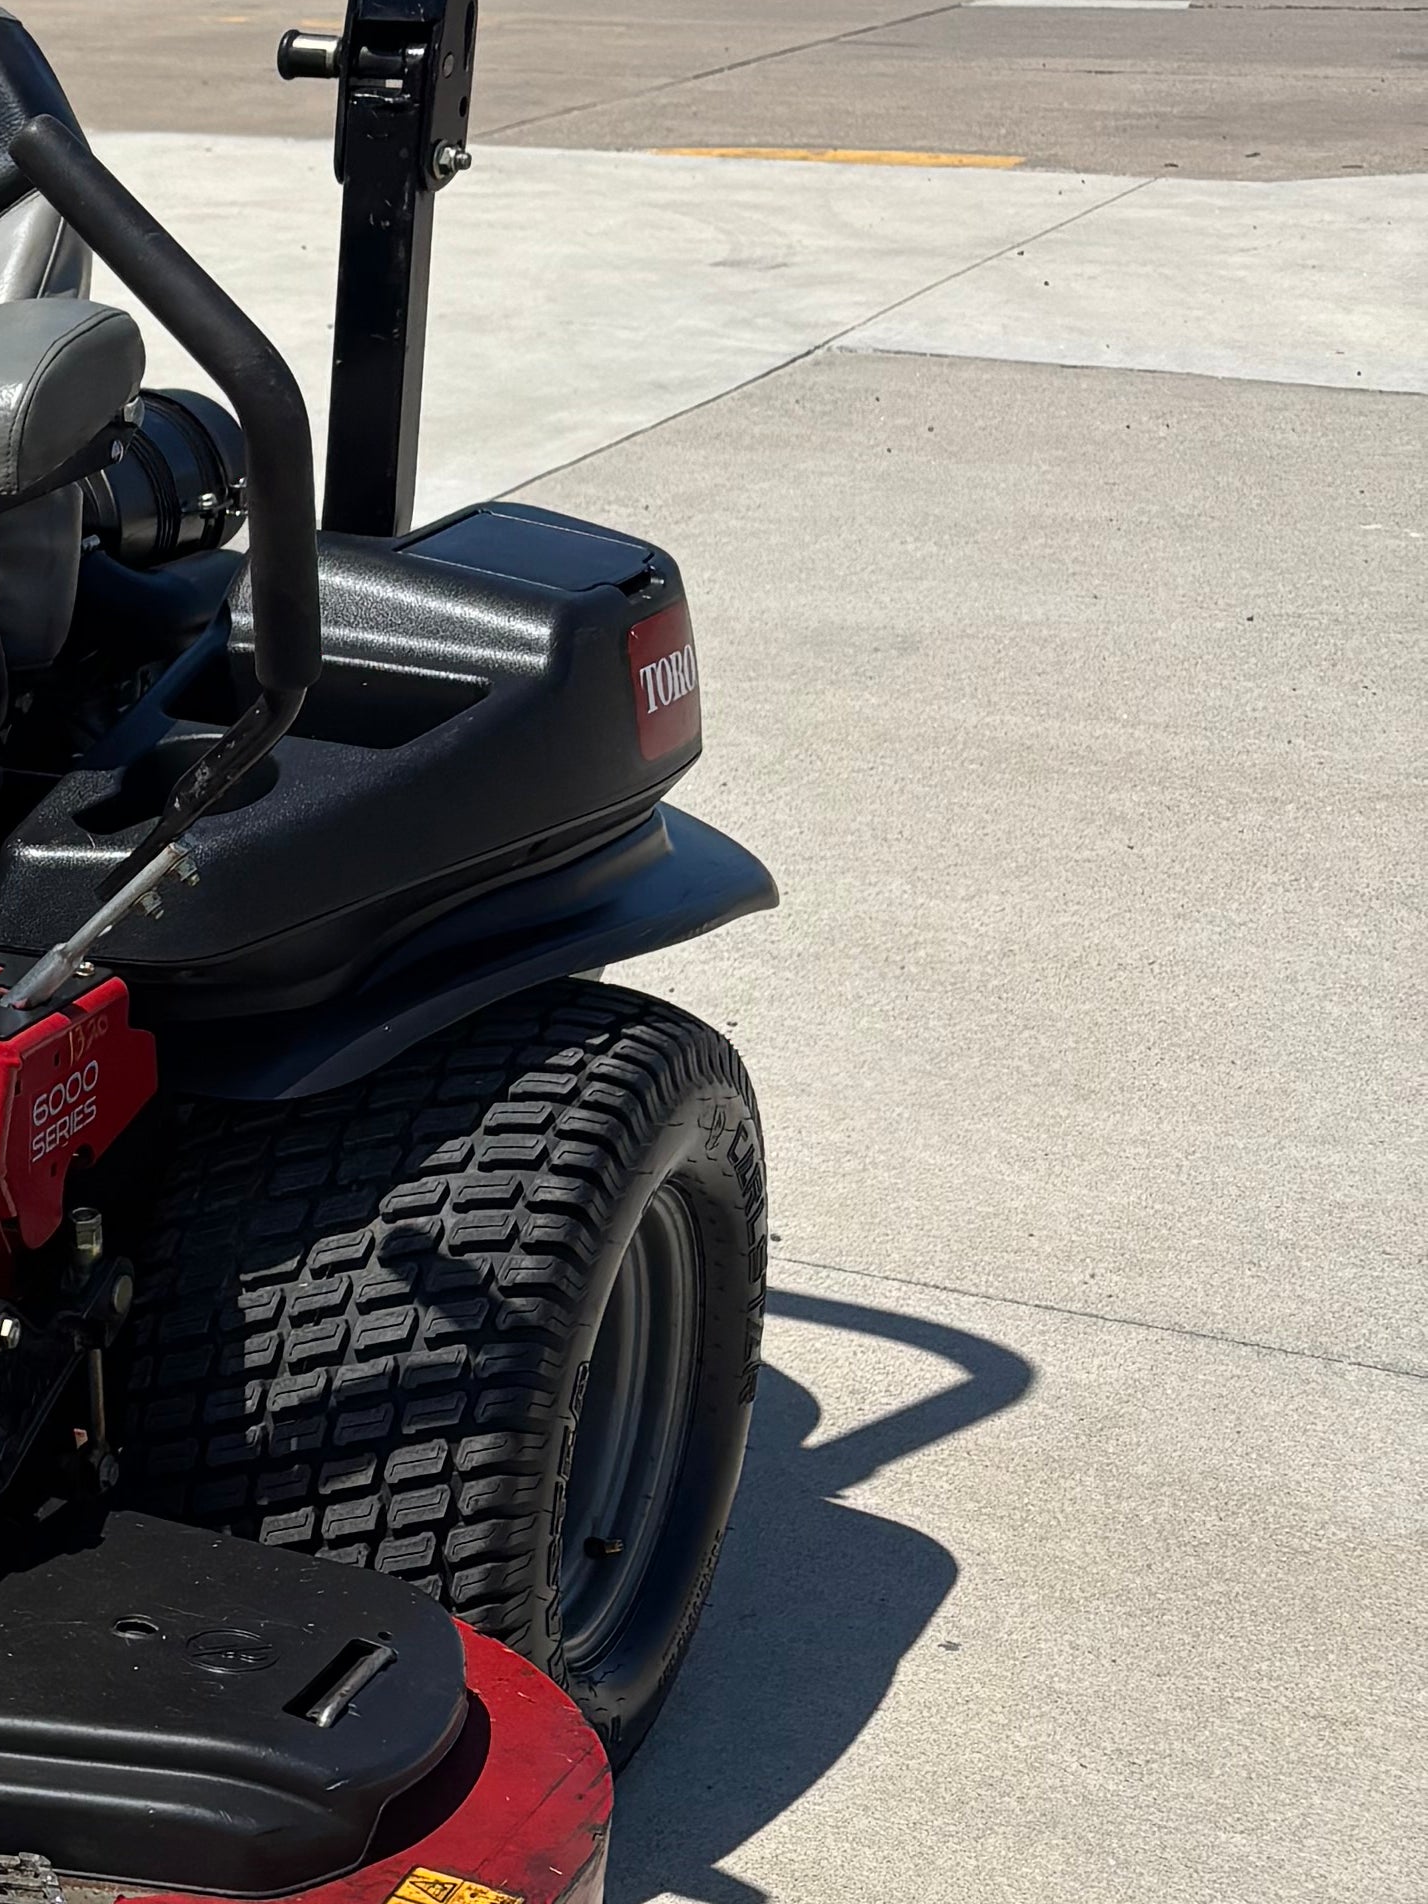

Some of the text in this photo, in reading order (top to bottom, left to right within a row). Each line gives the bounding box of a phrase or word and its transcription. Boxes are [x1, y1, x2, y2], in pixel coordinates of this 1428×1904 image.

[639, 644, 697, 714] TORO
[32, 1059, 100, 1127] 6000
[31, 1095, 98, 1164] SERIES
